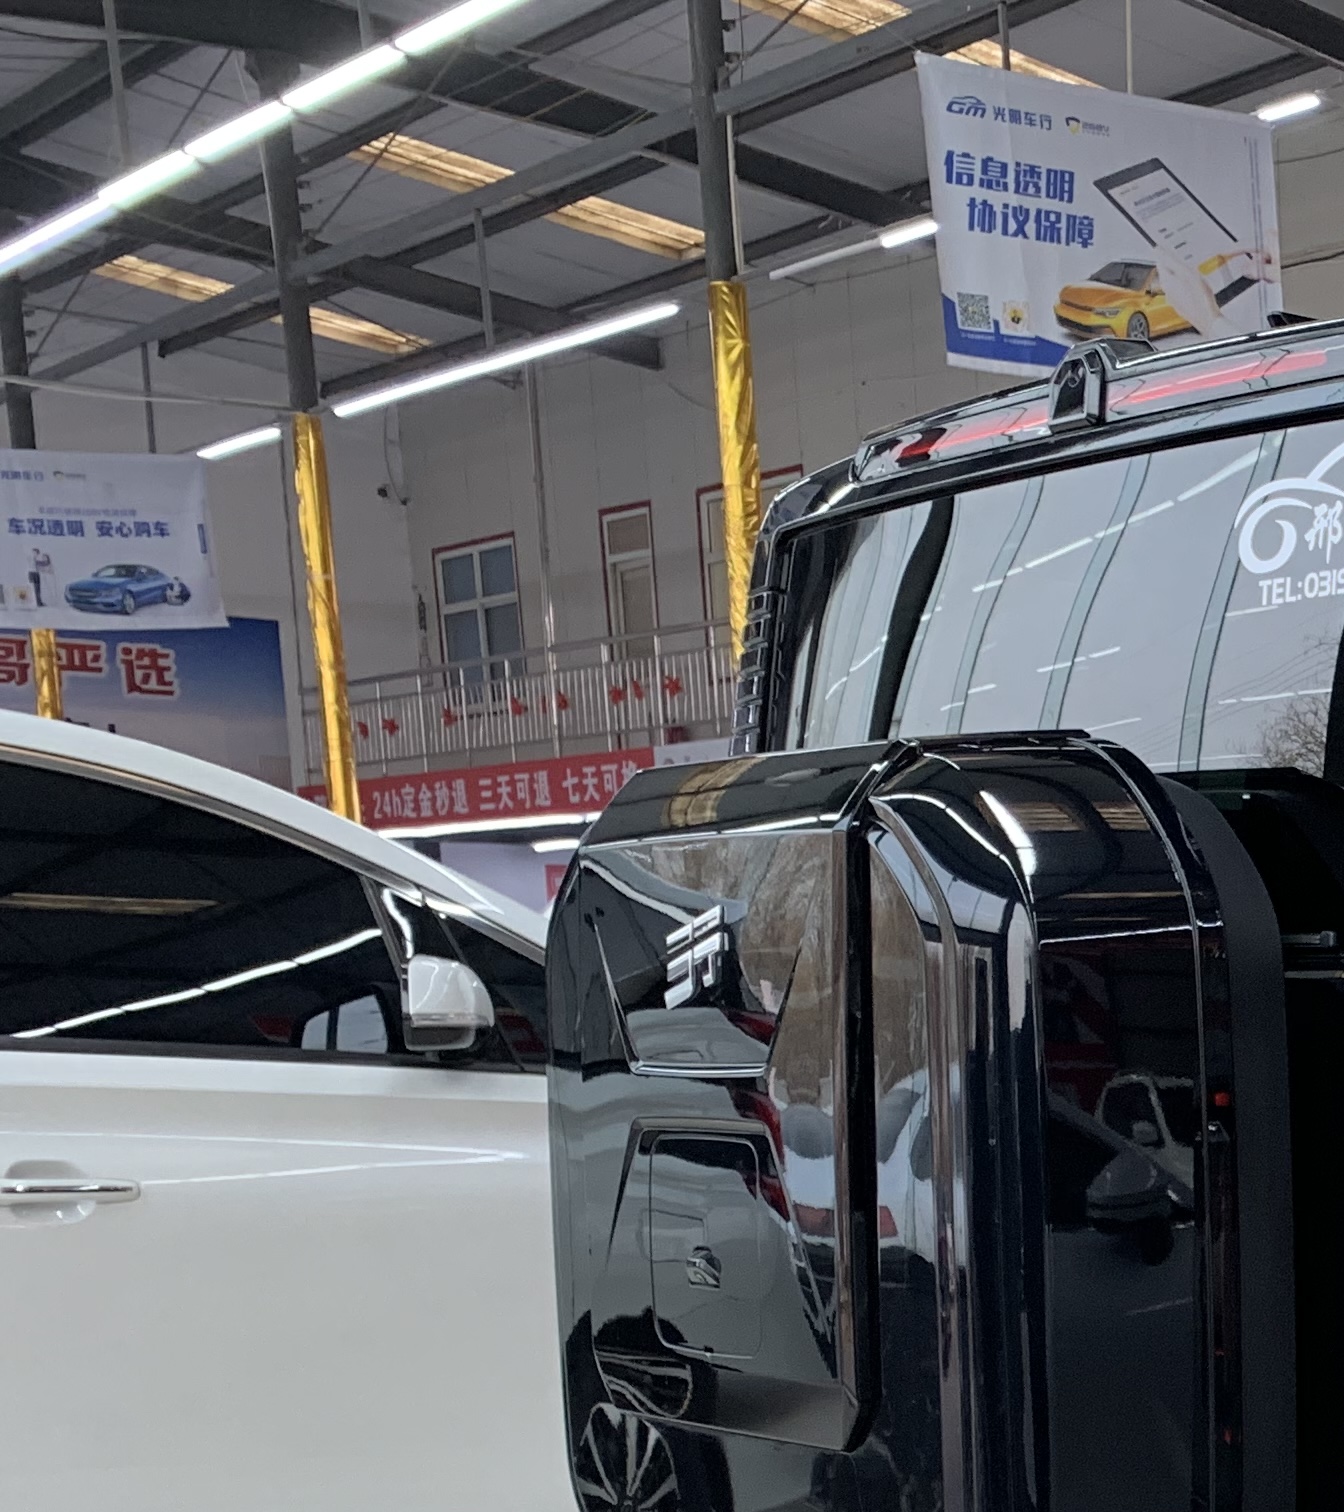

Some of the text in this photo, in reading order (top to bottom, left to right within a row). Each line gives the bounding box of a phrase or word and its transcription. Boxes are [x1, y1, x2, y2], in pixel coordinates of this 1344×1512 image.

[943, 149, 1075, 205] 信息透明
[966, 197, 1095, 249] 协议保障
[478, 768, 552, 812] 三天可退
